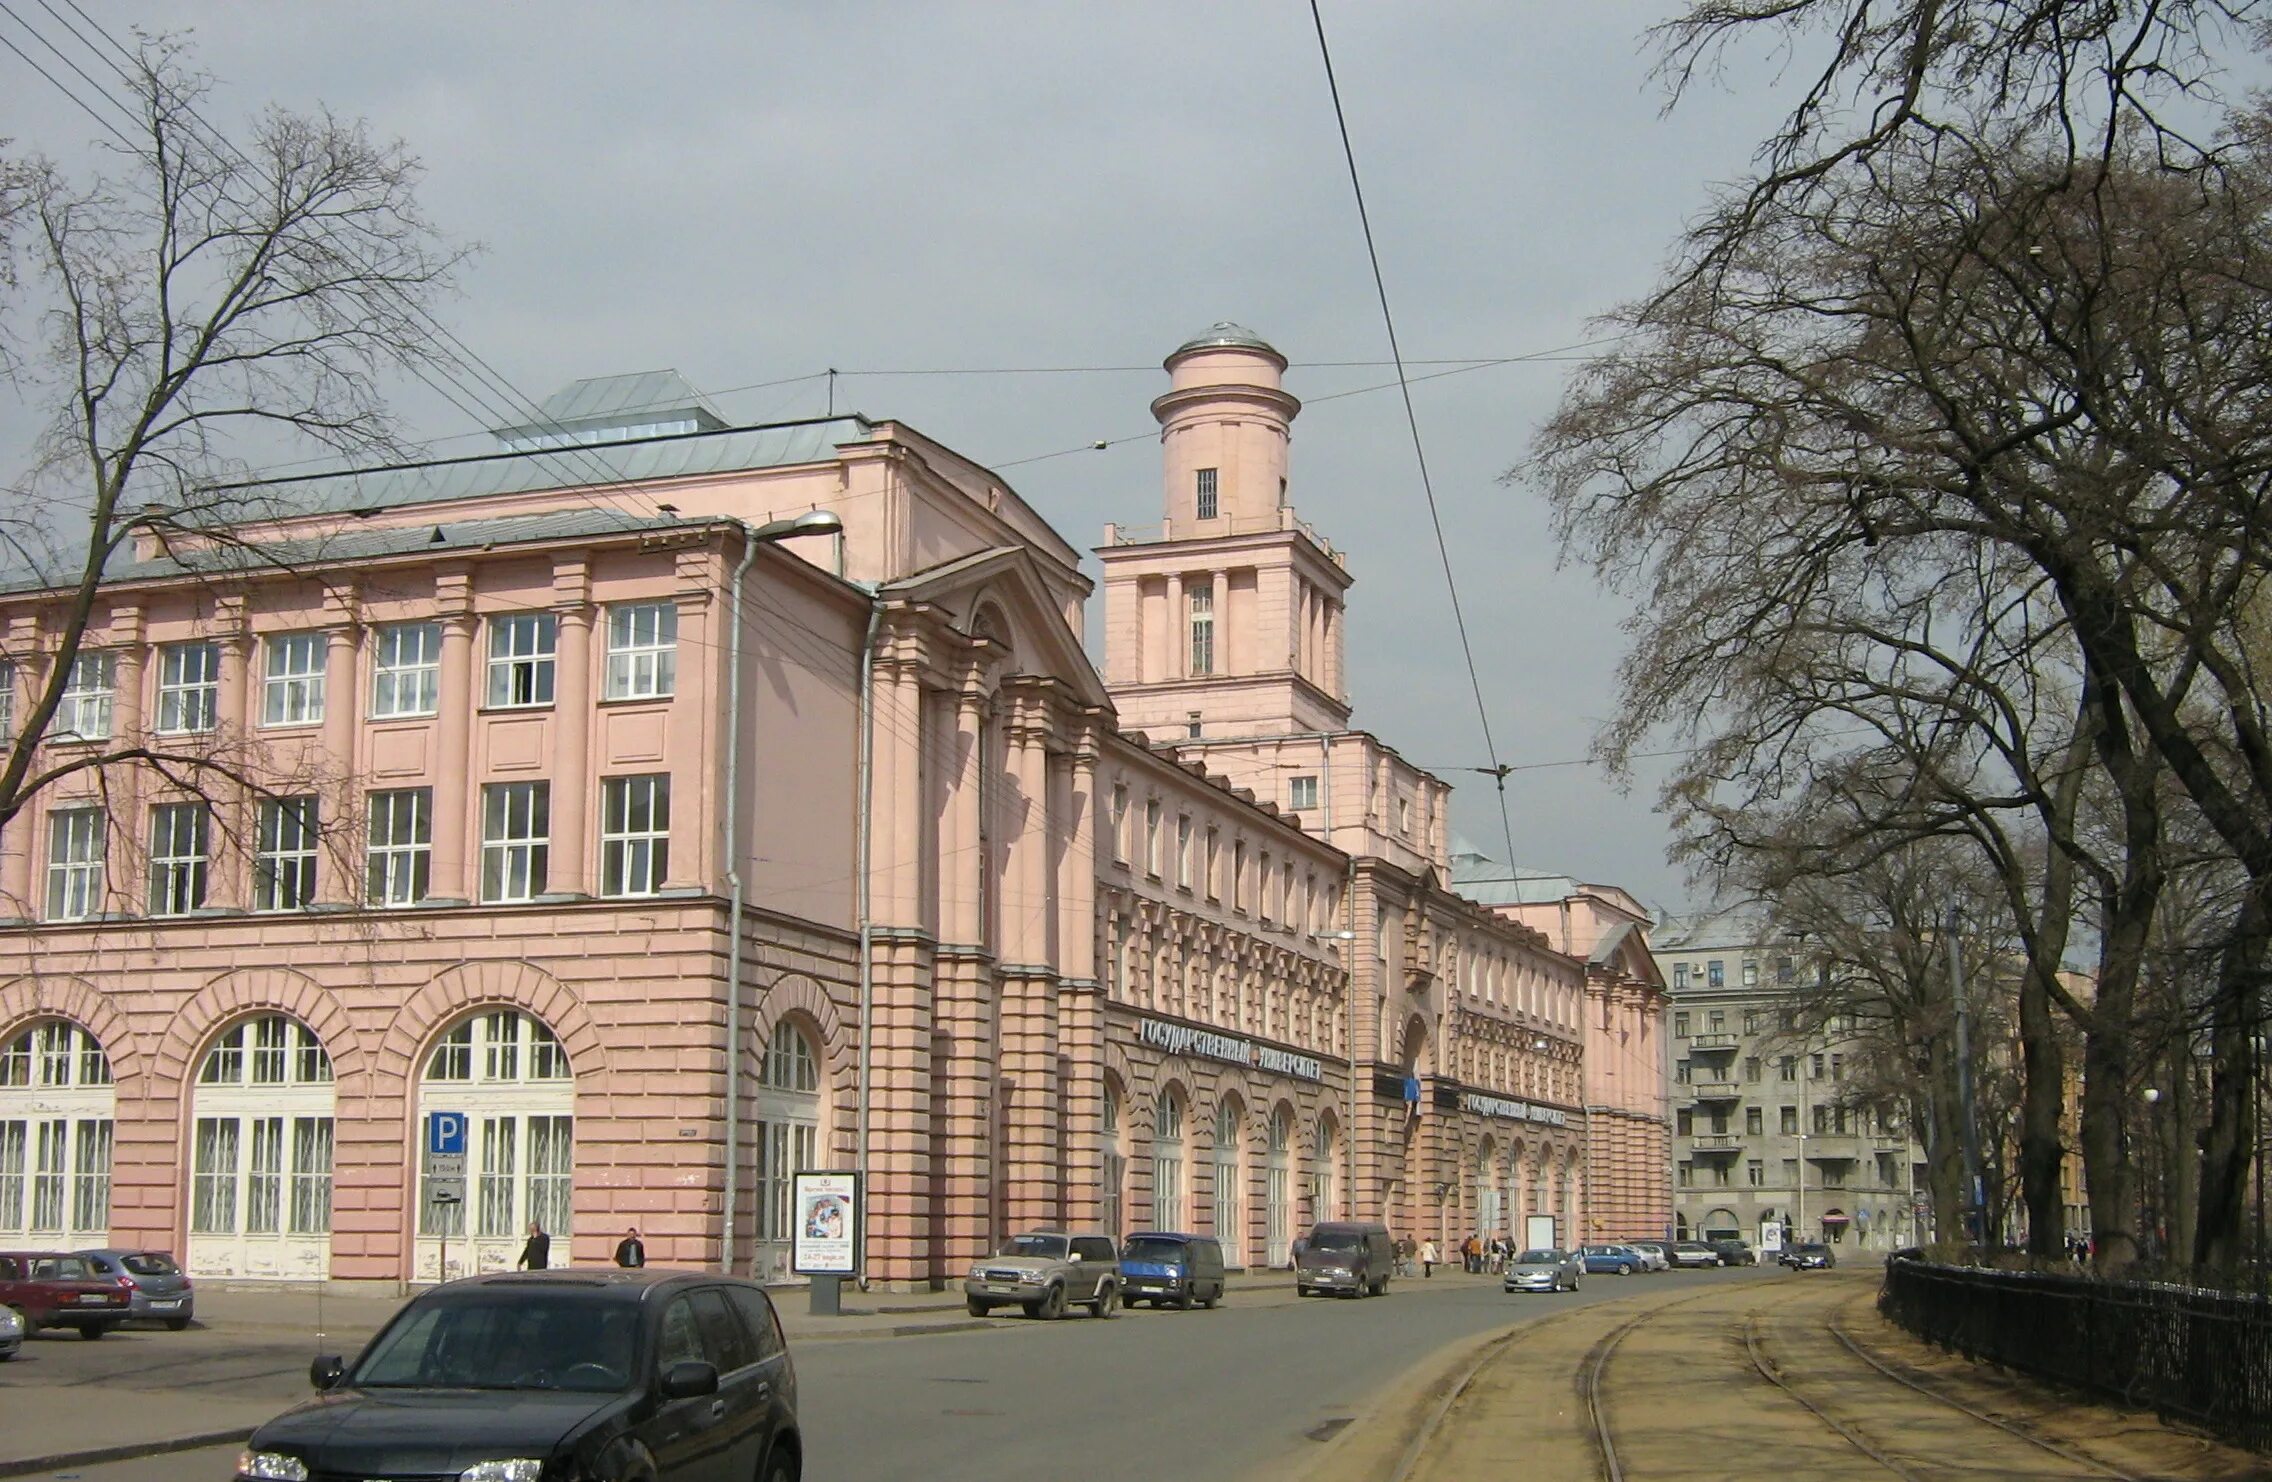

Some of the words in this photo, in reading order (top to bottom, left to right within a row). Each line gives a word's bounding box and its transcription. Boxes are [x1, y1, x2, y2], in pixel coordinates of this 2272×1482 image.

[1140, 1018, 1250, 1065] ГОСУДАРСТВЕННЫЙ
[1259, 1046, 1321, 1080] УНИВЕРСИТЕТ
[439, 1116, 458, 1150] P
